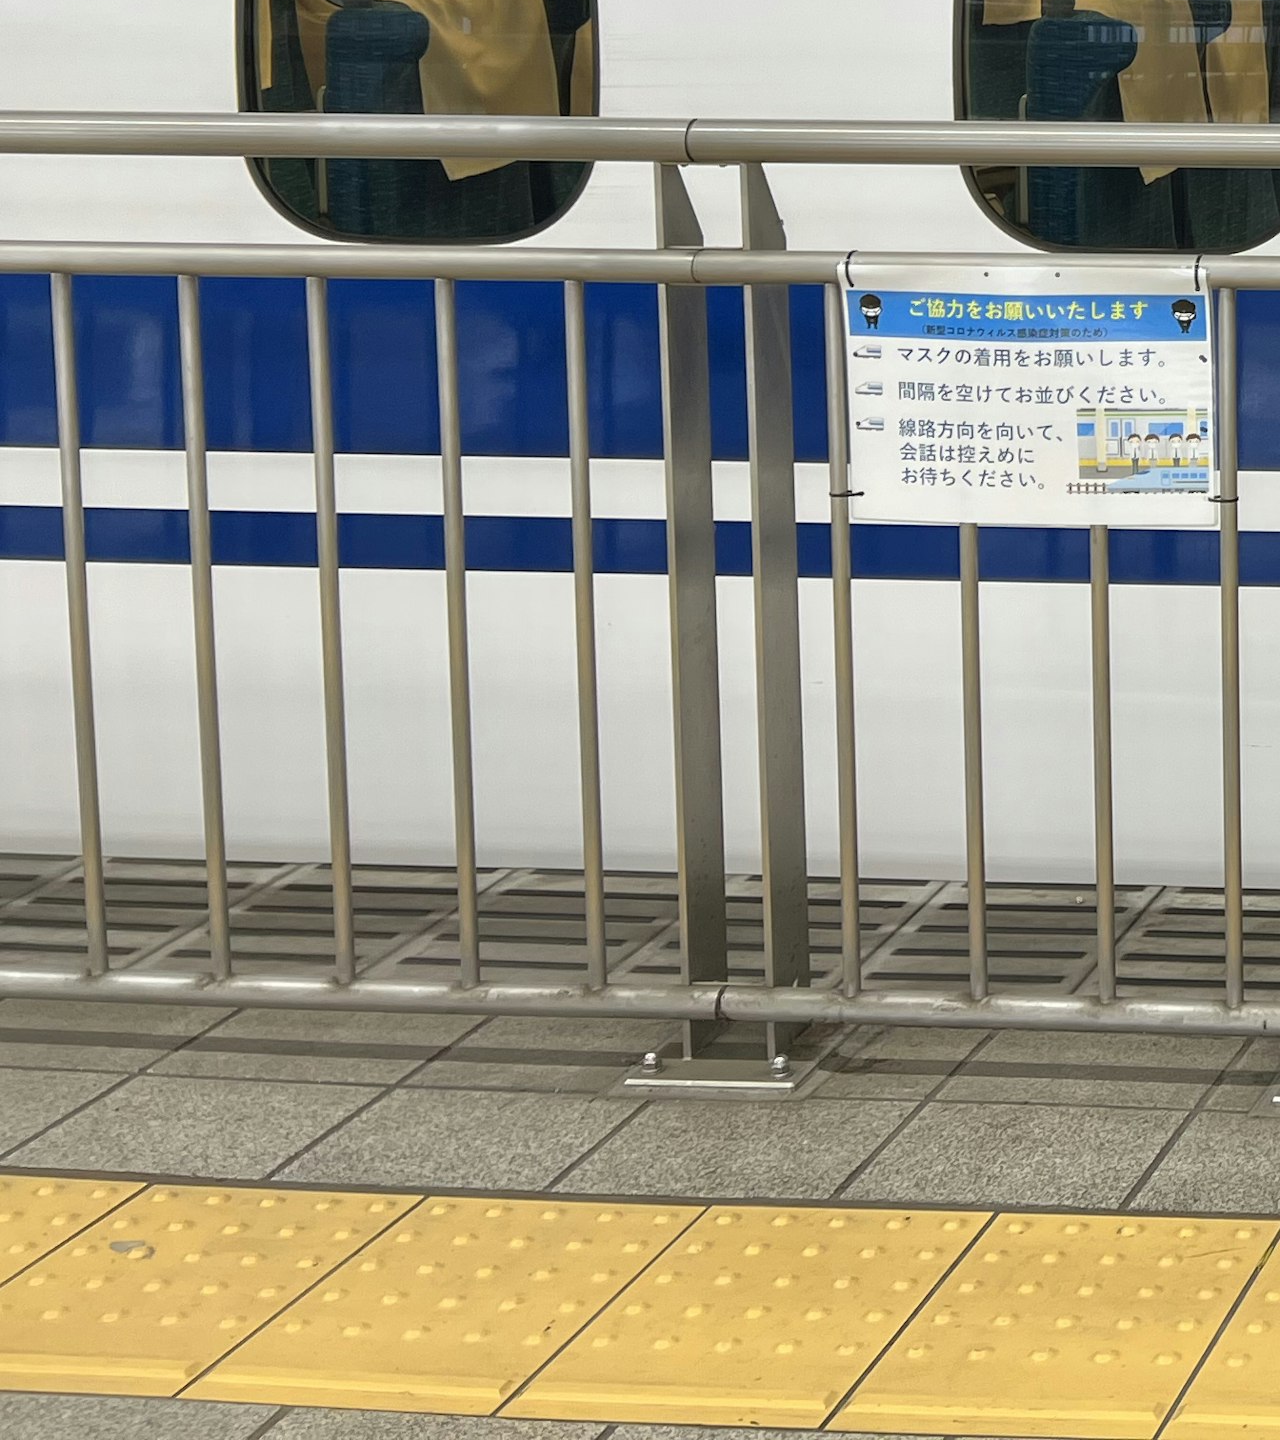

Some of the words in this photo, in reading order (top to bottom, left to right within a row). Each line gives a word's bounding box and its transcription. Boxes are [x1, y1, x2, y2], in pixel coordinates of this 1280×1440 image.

[909, 298, 1149, 321] ご協力をお願いいたします
[897, 346, 1166, 369] マスクの着用をお願いします。
[897, 381, 1168, 405] 間隔を空けてお並びください。
[898, 417, 1064, 442] 線路方向を向いて、
[899, 442, 1035, 464] 会話は控えめに
[901, 466, 1045, 490] お待ちください。
